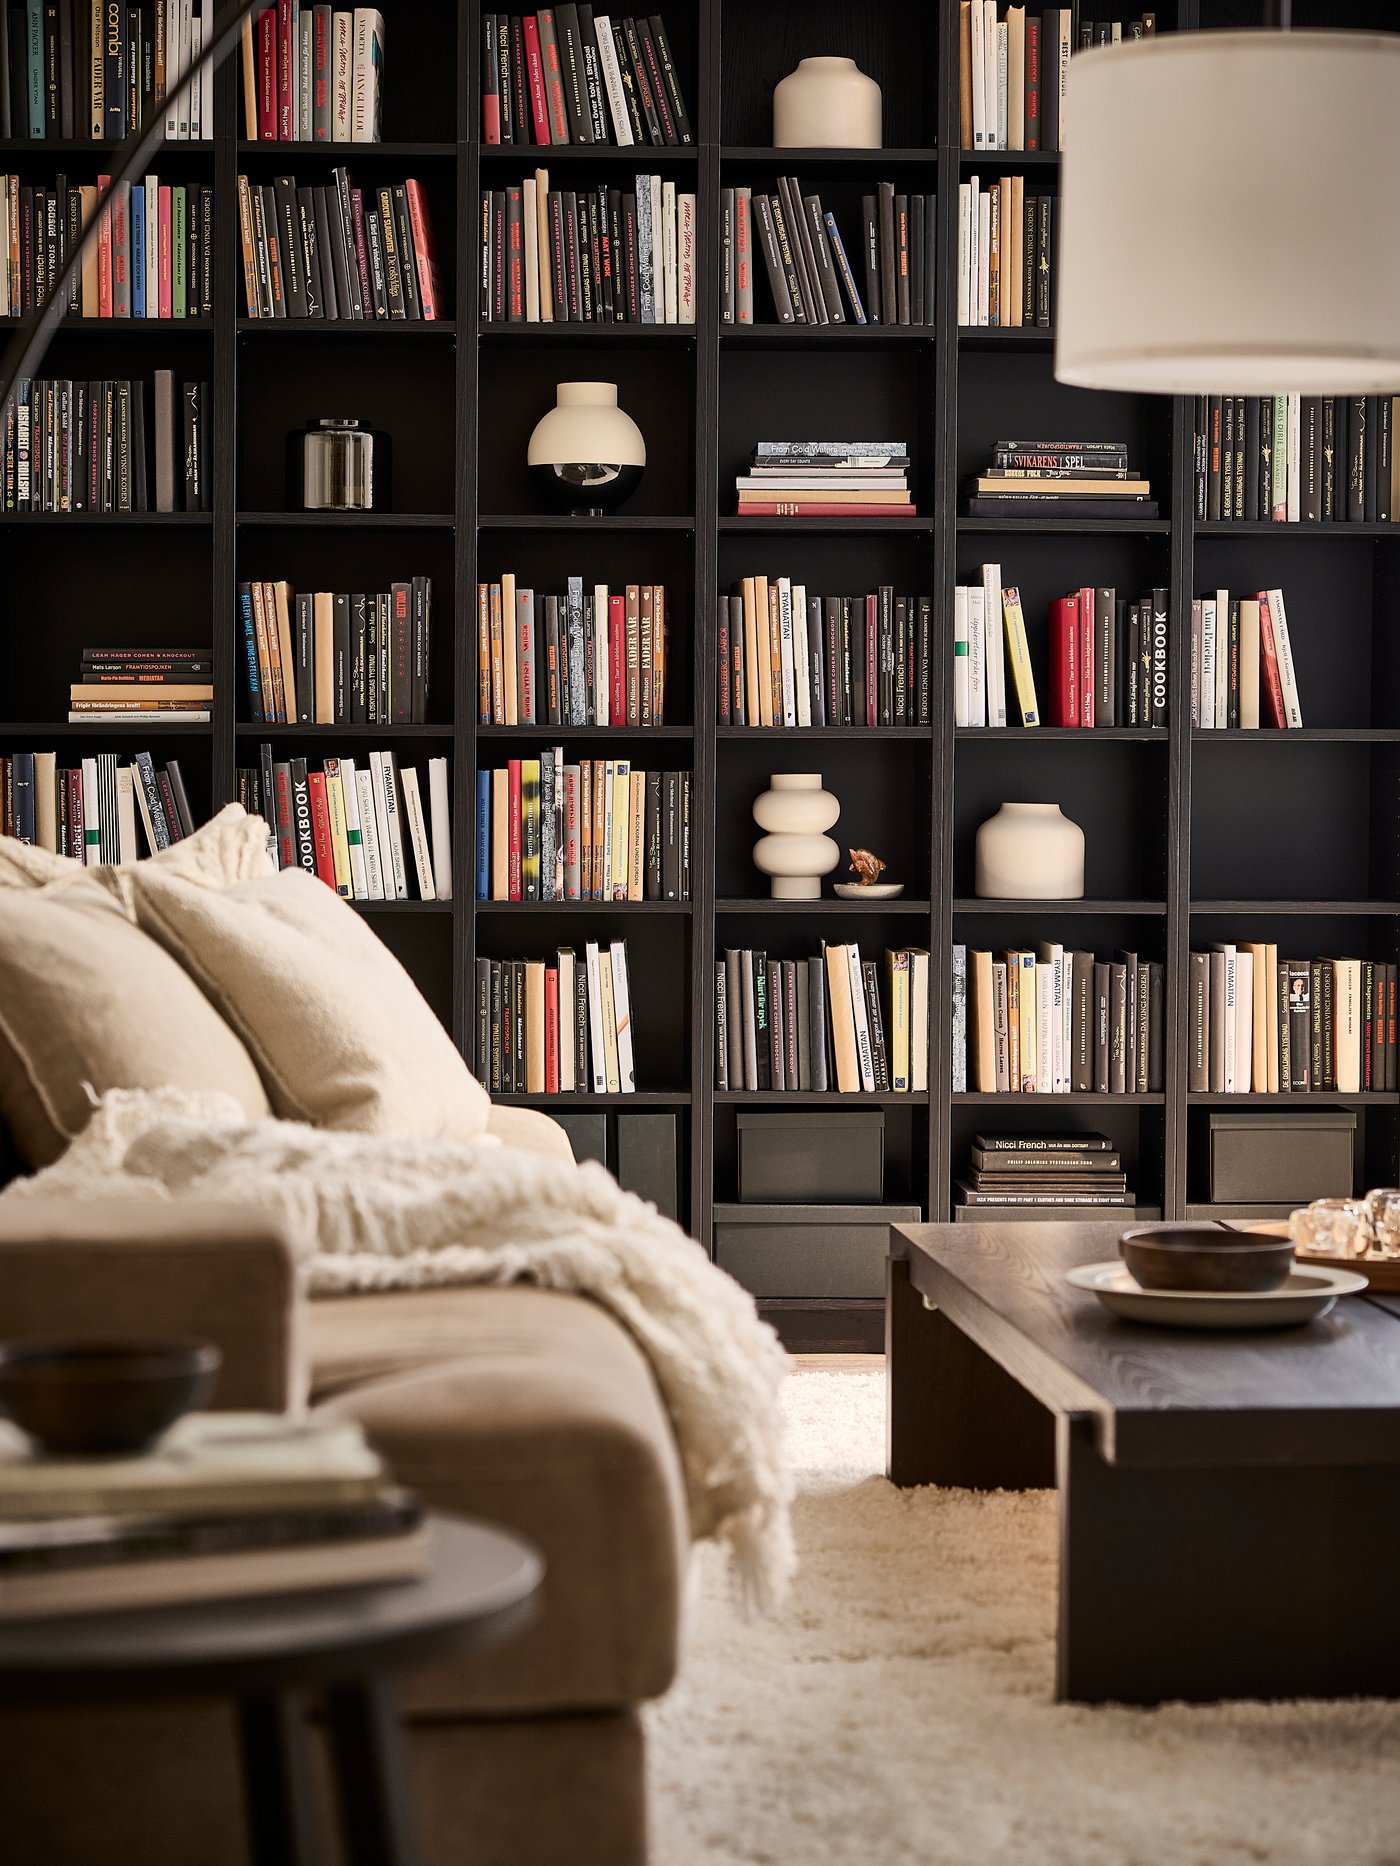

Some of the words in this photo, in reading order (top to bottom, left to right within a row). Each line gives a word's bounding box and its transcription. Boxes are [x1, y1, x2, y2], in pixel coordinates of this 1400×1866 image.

[31, 12, 39, 29] ANN
[108, 3, 122, 57] combi
[31, 29, 39, 56] PACKER
[499, 26, 509, 47] Nicci
[94, 57, 102, 88] FADER
[500, 49, 510, 78] French
[584, 46, 594, 76] Bhopal
[356, 72, 365, 90] JAN
[589, 82, 597, 98] tolv
[591, 99, 599, 119] över
[593, 121, 601, 140] Fem
[381, 192, 390, 218] CAROLYN
[383, 219, 393, 253] SLAUGHTER
[602, 236, 610, 253] MAT
[37, 255, 45, 282] French
[18, 406, 30, 450] RISKABELT
[1014, 456, 1057, 468] SVIKARENS
[1065, 456, 1085, 468] SPEL
[18, 461, 30, 501] ROLLSPEL
[241, 595, 251, 618] HILLEVI
[396, 590, 407, 618] WOLLTER
[782, 592, 790, 640] RYAMATTAN
[1204, 608, 1214, 630] Ann
[720, 659, 728, 686] SEEBERG
[1155, 611, 1166, 708] COOKBOOK
[896, 664, 904, 692] French
[720, 688, 728, 716] STAFFAN
[896, 694, 904, 716] Nicci
[142, 766, 150, 785] From
[147, 786, 156, 804] Cold
[384, 766, 395, 814] RYAMATTAN
[717, 972, 725, 994] Nicci
[757, 976, 766, 996] Klart
[578, 998, 586, 1026] French
[717, 996, 725, 1024] French
[757, 1009, 766, 1030] tryck
[995, 1140, 1017, 1149] Nicci
[1018, 1140, 1046, 1149] French
